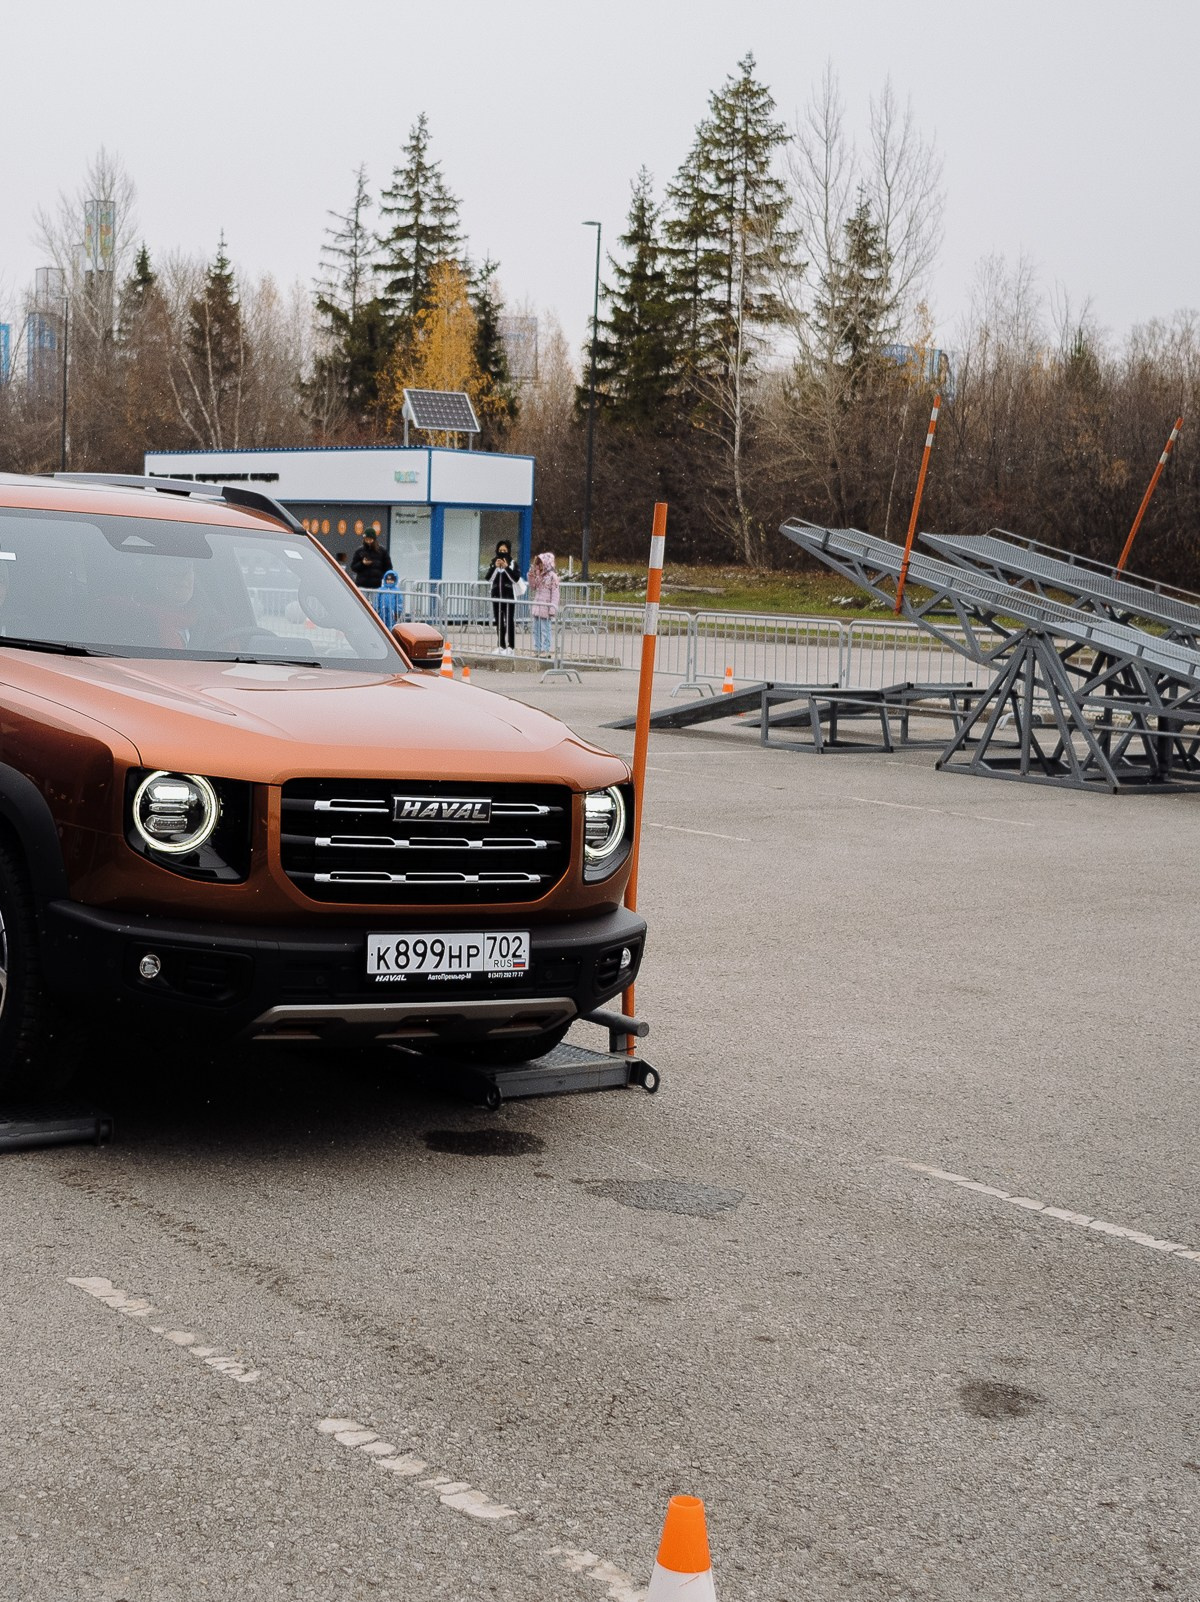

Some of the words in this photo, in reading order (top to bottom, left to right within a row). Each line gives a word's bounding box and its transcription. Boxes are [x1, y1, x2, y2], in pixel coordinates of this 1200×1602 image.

[400, 801, 487, 819] HAVAL
[376, 938, 480, 970] К899НР
[486, 935, 523, 960] 702
[493, 958, 513, 968] RUS
[375, 974, 407, 982] HAVAL
[427, 973, 472, 981] АвтоПремьер-М
